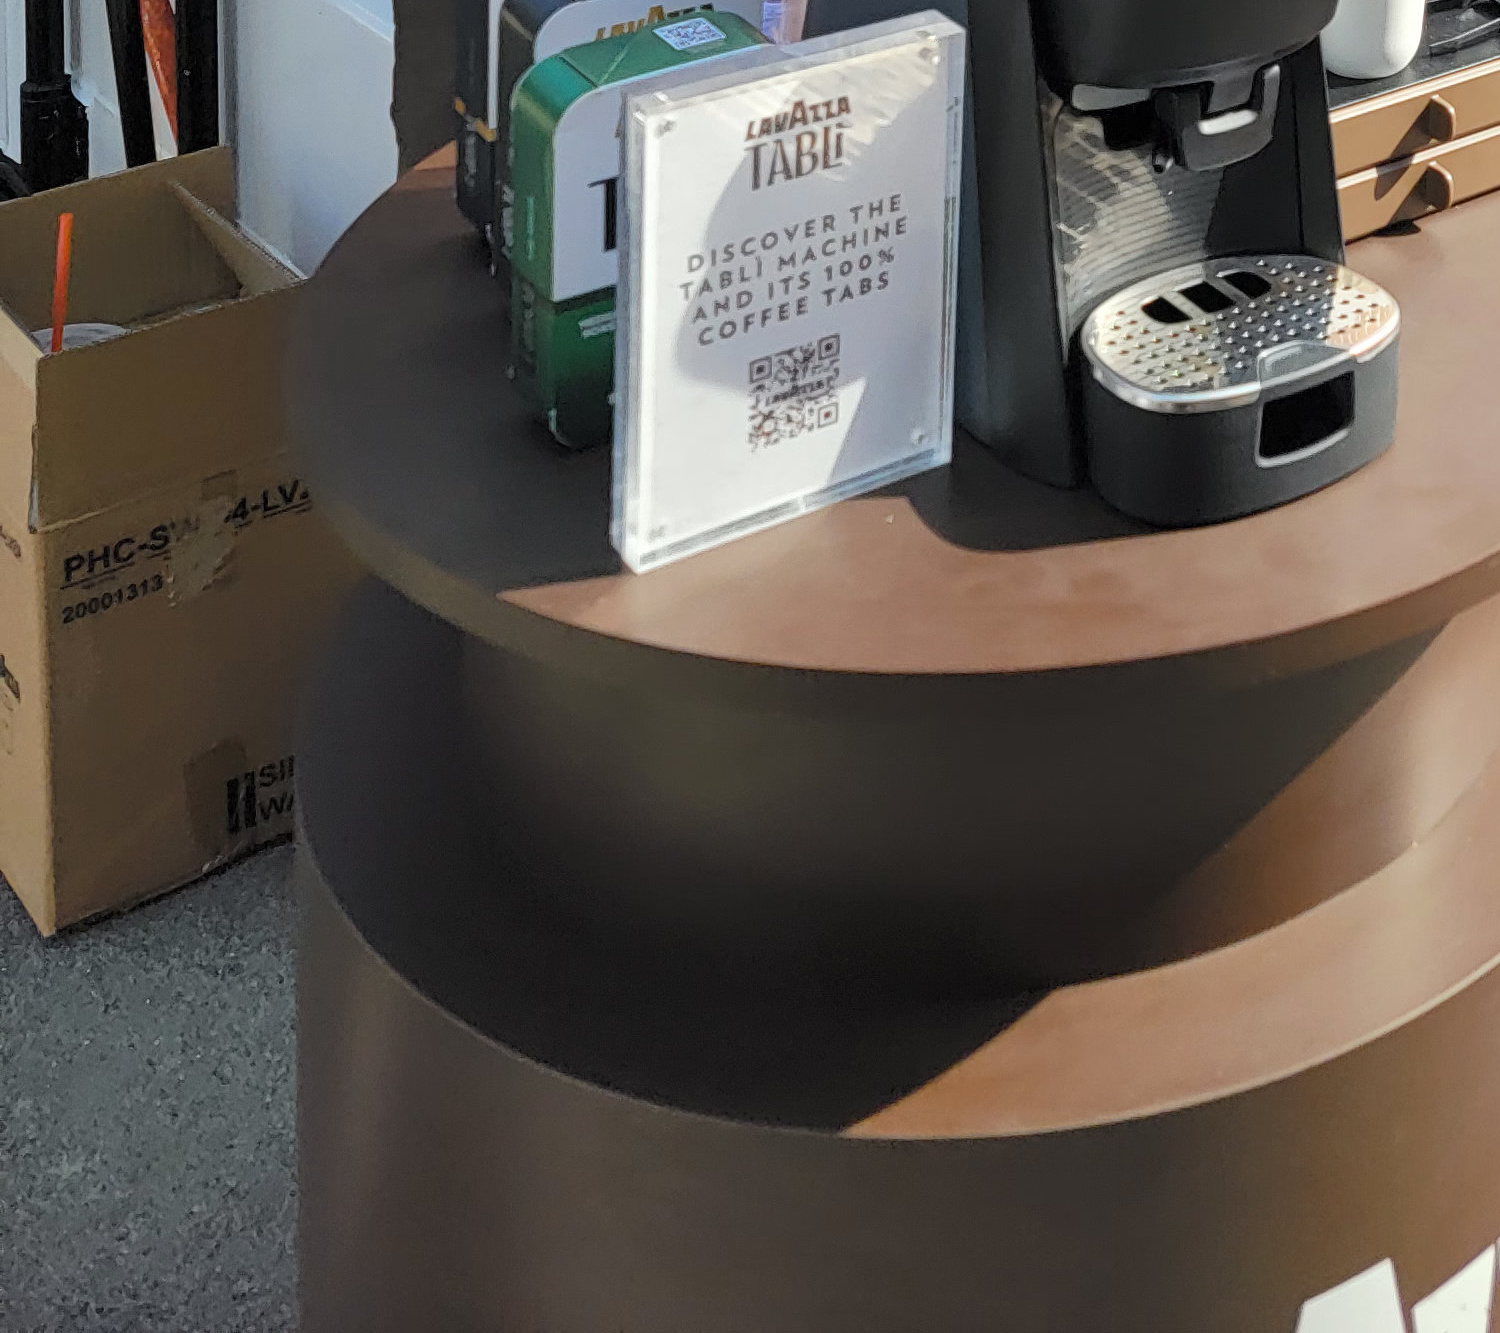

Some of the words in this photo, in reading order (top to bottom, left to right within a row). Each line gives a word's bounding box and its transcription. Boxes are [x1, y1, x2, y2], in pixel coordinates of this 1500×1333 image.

[744, 95, 852, 143] LAVAZZA
[688, 214, 835, 273] DISCOVER
[850, 194, 902, 224] THE
[777, 217, 908, 271] MACHINE
[693, 290, 753, 323] AND
[768, 271, 811, 300] ITS
[825, 247, 895, 281] 100%
[698, 296, 809, 346] COFFEE
[821, 271, 889, 307] TABS
